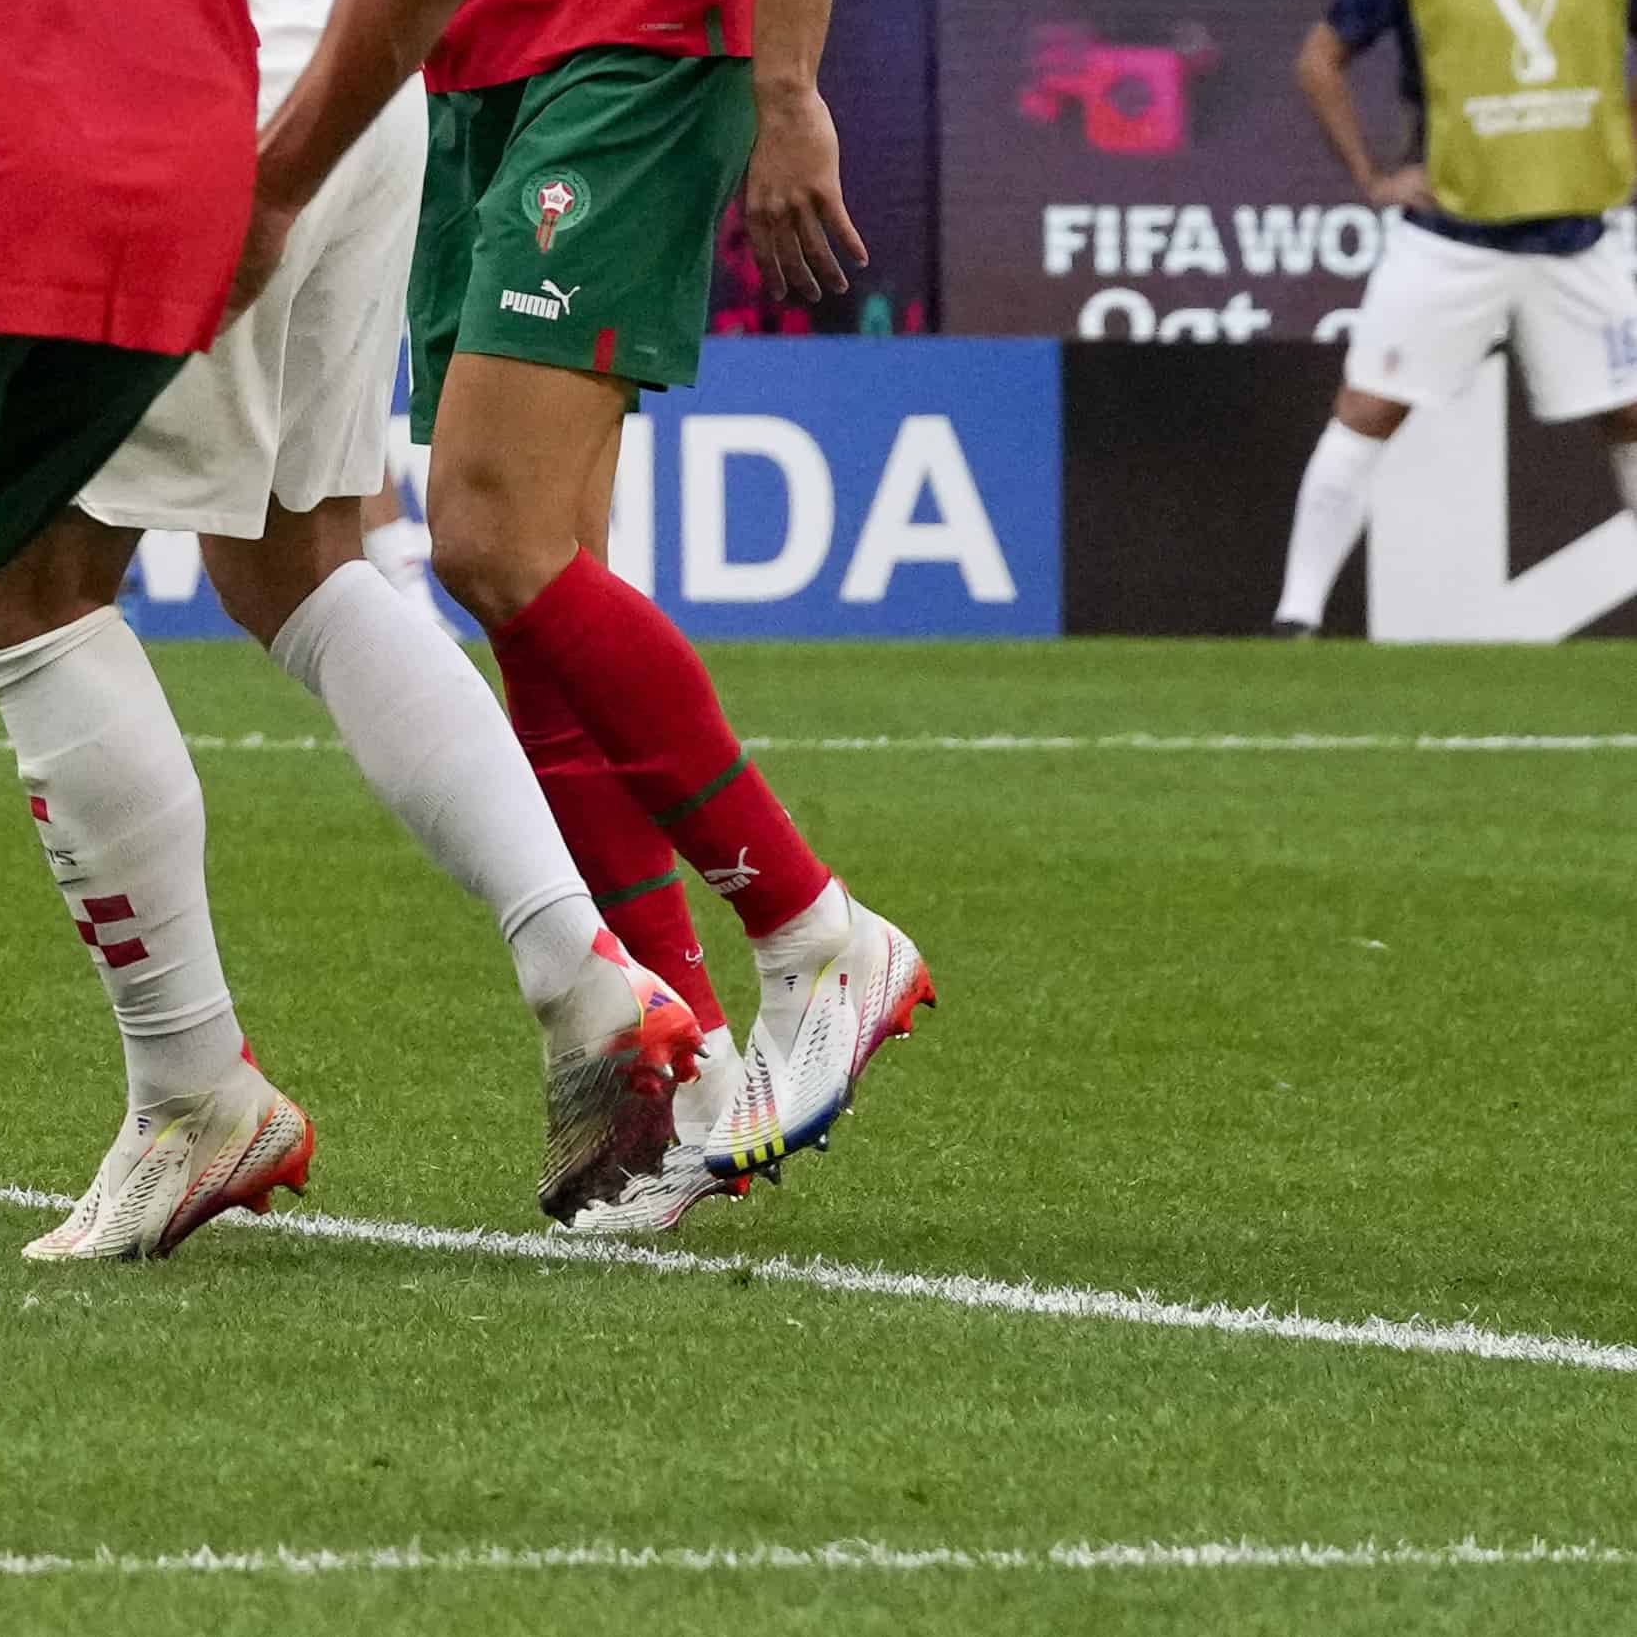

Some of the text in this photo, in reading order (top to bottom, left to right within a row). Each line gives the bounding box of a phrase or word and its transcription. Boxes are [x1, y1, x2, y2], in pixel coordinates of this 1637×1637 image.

[1043, 204, 1401, 278] FIFA WO
[499, 289, 561, 321] PUMA
